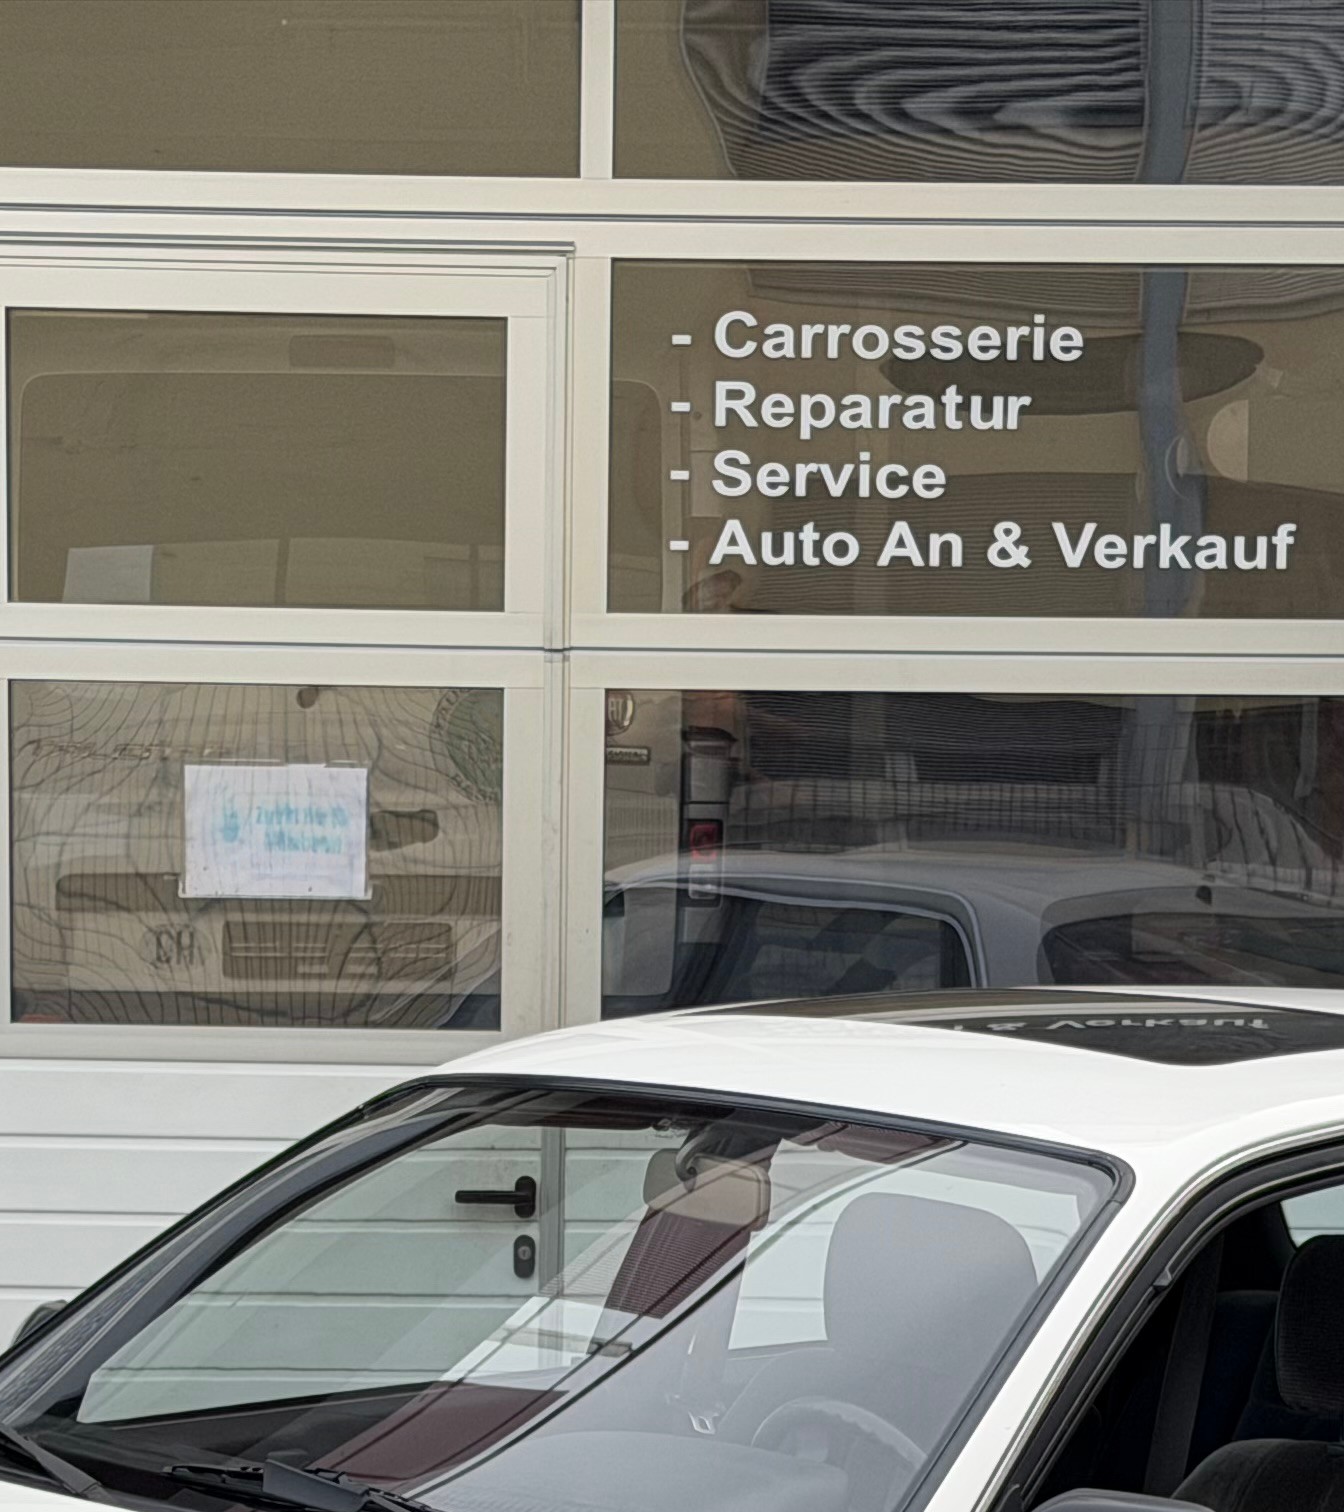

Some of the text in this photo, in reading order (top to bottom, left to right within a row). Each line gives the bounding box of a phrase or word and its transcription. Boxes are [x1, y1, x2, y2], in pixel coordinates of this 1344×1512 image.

[713, 309, 1085, 362] Carrosserie
[713, 379, 1033, 441] Reparatur
[710, 448, 947, 500] Service
[708, 518, 861, 568] Auto
[876, 520, 964, 568] An
[986, 520, 1033, 569] &
[1051, 521, 1298, 571] Verkauf
